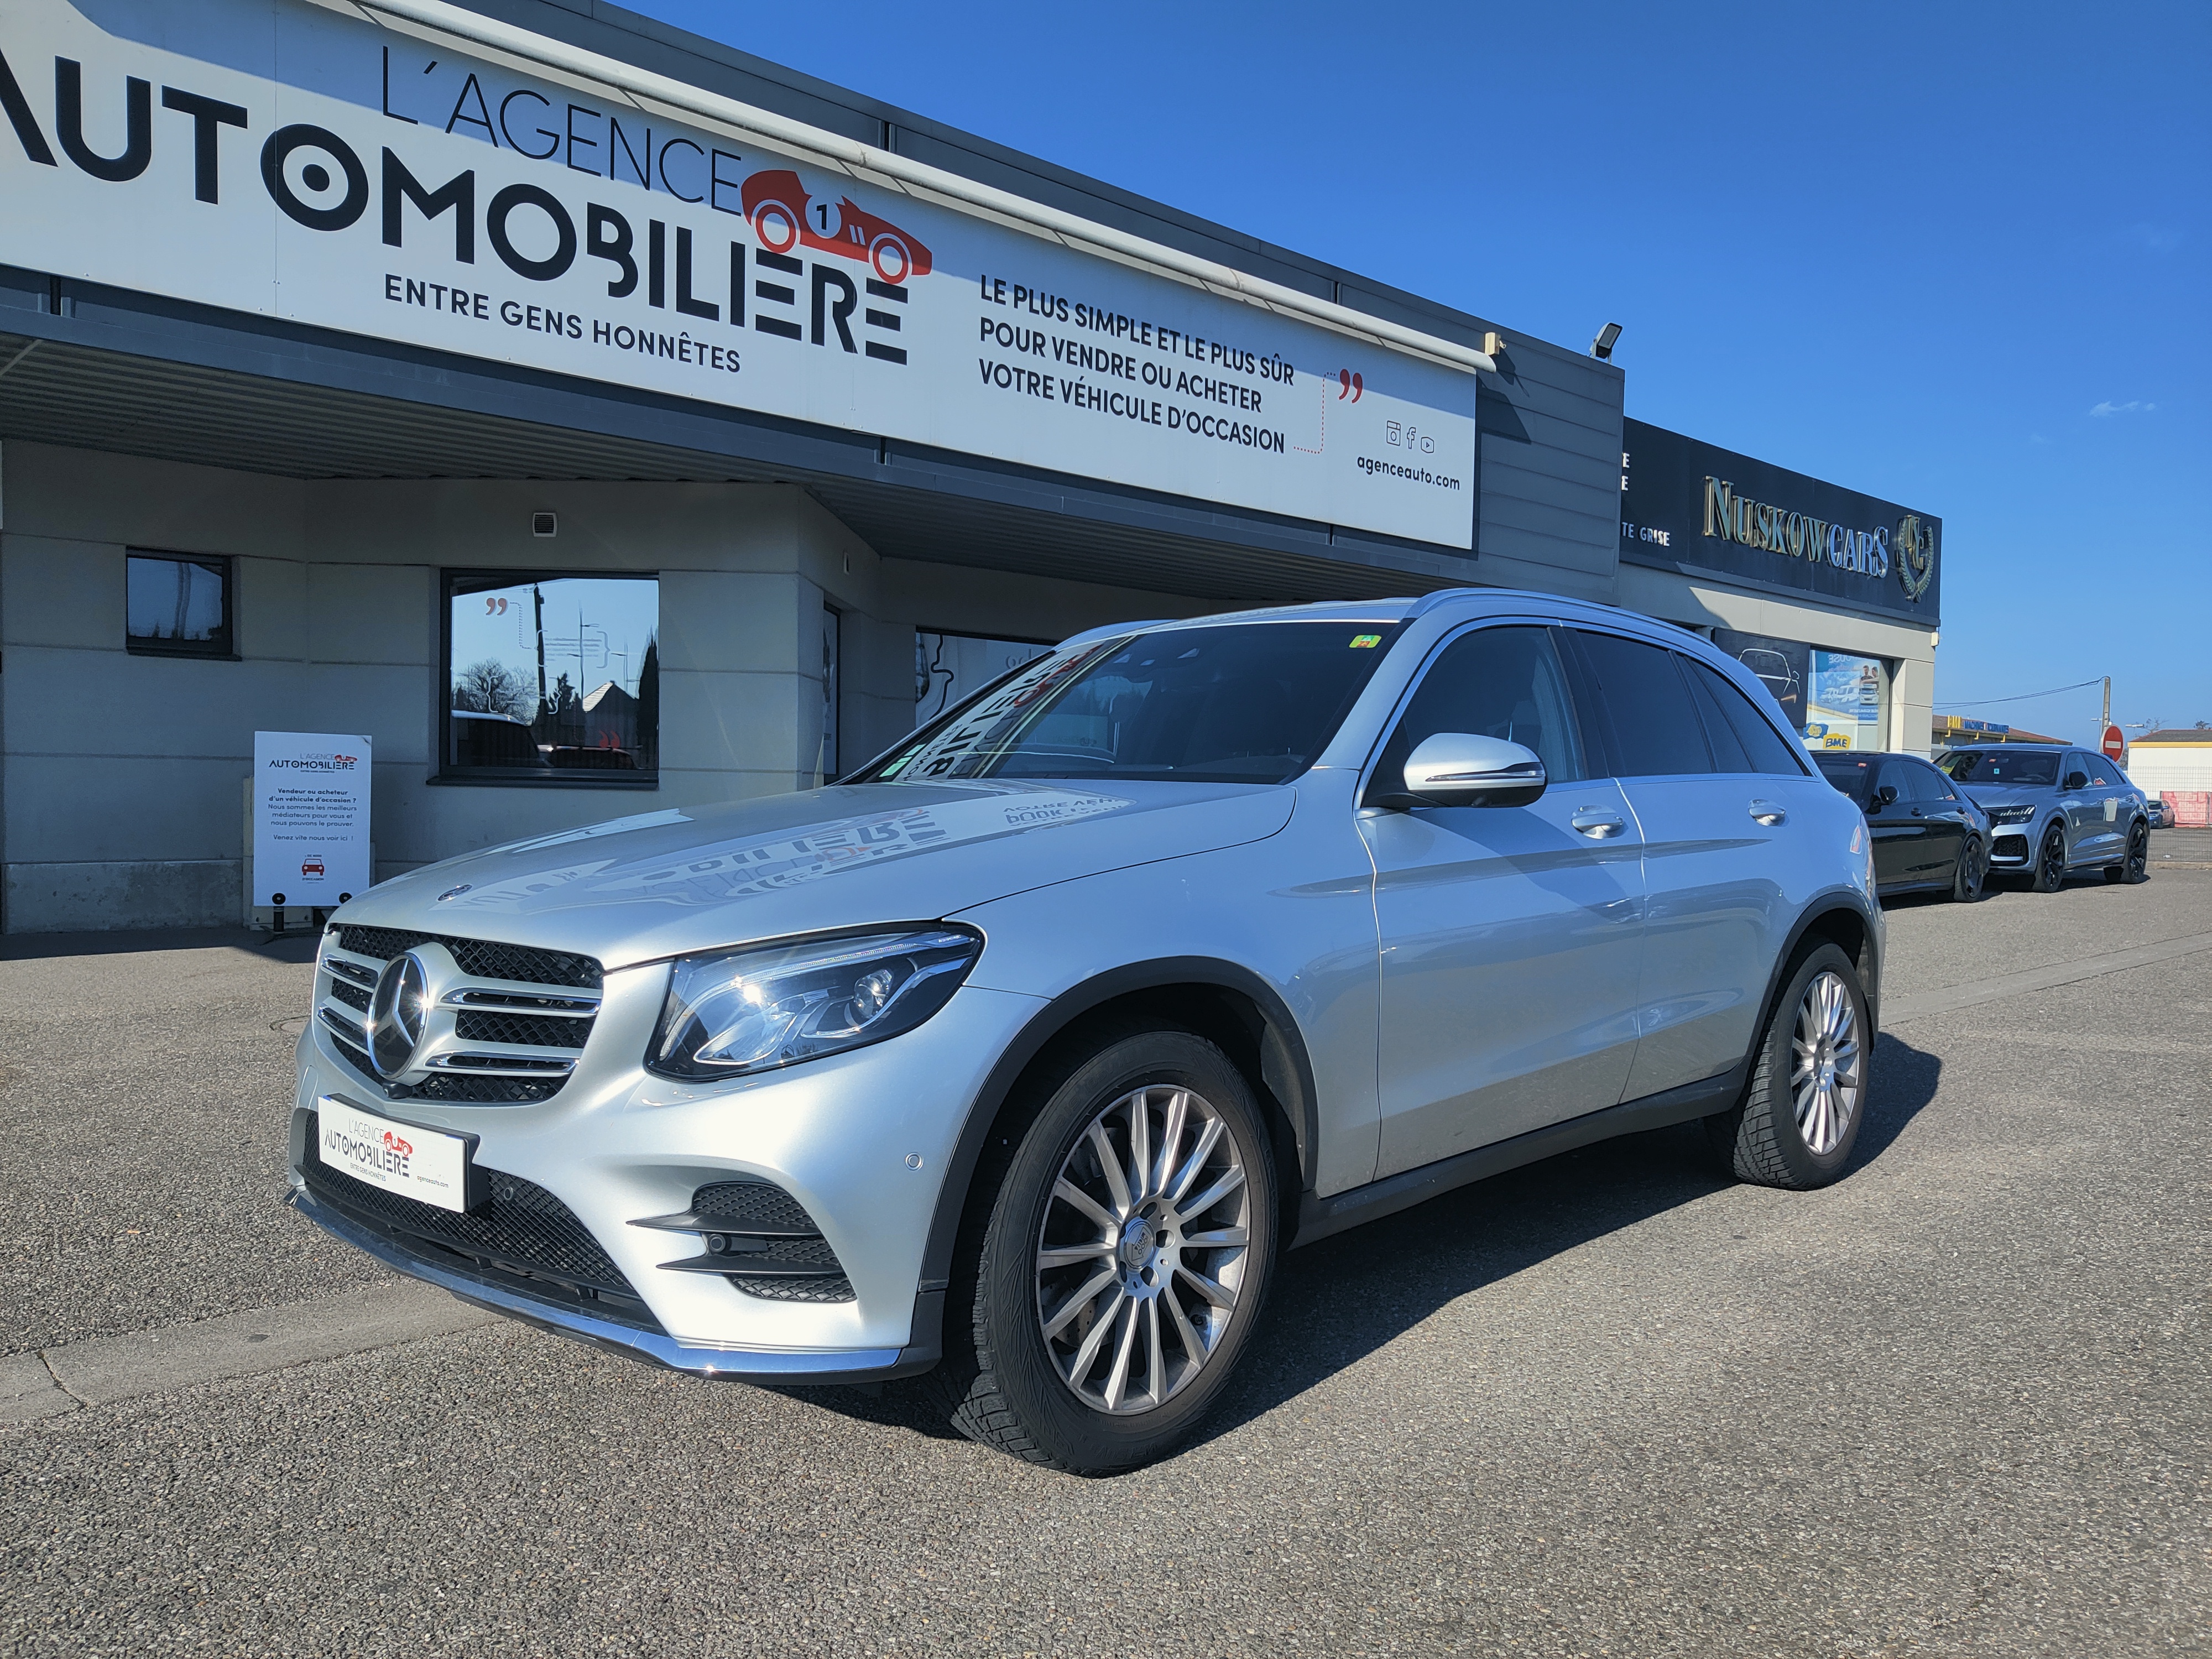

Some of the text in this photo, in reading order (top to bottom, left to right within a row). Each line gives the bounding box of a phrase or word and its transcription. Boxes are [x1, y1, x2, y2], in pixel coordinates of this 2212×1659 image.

[382, 45, 742, 217] L'AGENCE
[385, 273, 741, 374] ENTRE GENS HONNÊTES
[980, 274, 1295, 387] LE PLUS SIMPLE ET LE PLUS SÛR
[980, 316, 1262, 414] POUR VENDRE OU ACHETER
[979, 358, 1285, 455] VOTRE VÉHICULE D'OCCASION
[1357, 454, 1460, 491] agenceauto.com
[1639, 527, 1671, 547] GRISE
[269, 760, 355, 770] AUTOMOBILIERE
[325, 1128, 410, 1178] AUTOMOBILIERE
[348, 1118, 385, 1145] L'AGENCE
[350, 1162, 387, 1182] ENTRE GENS HONNÊTES
[416, 1175, 449, 1188] agenceauto.com
